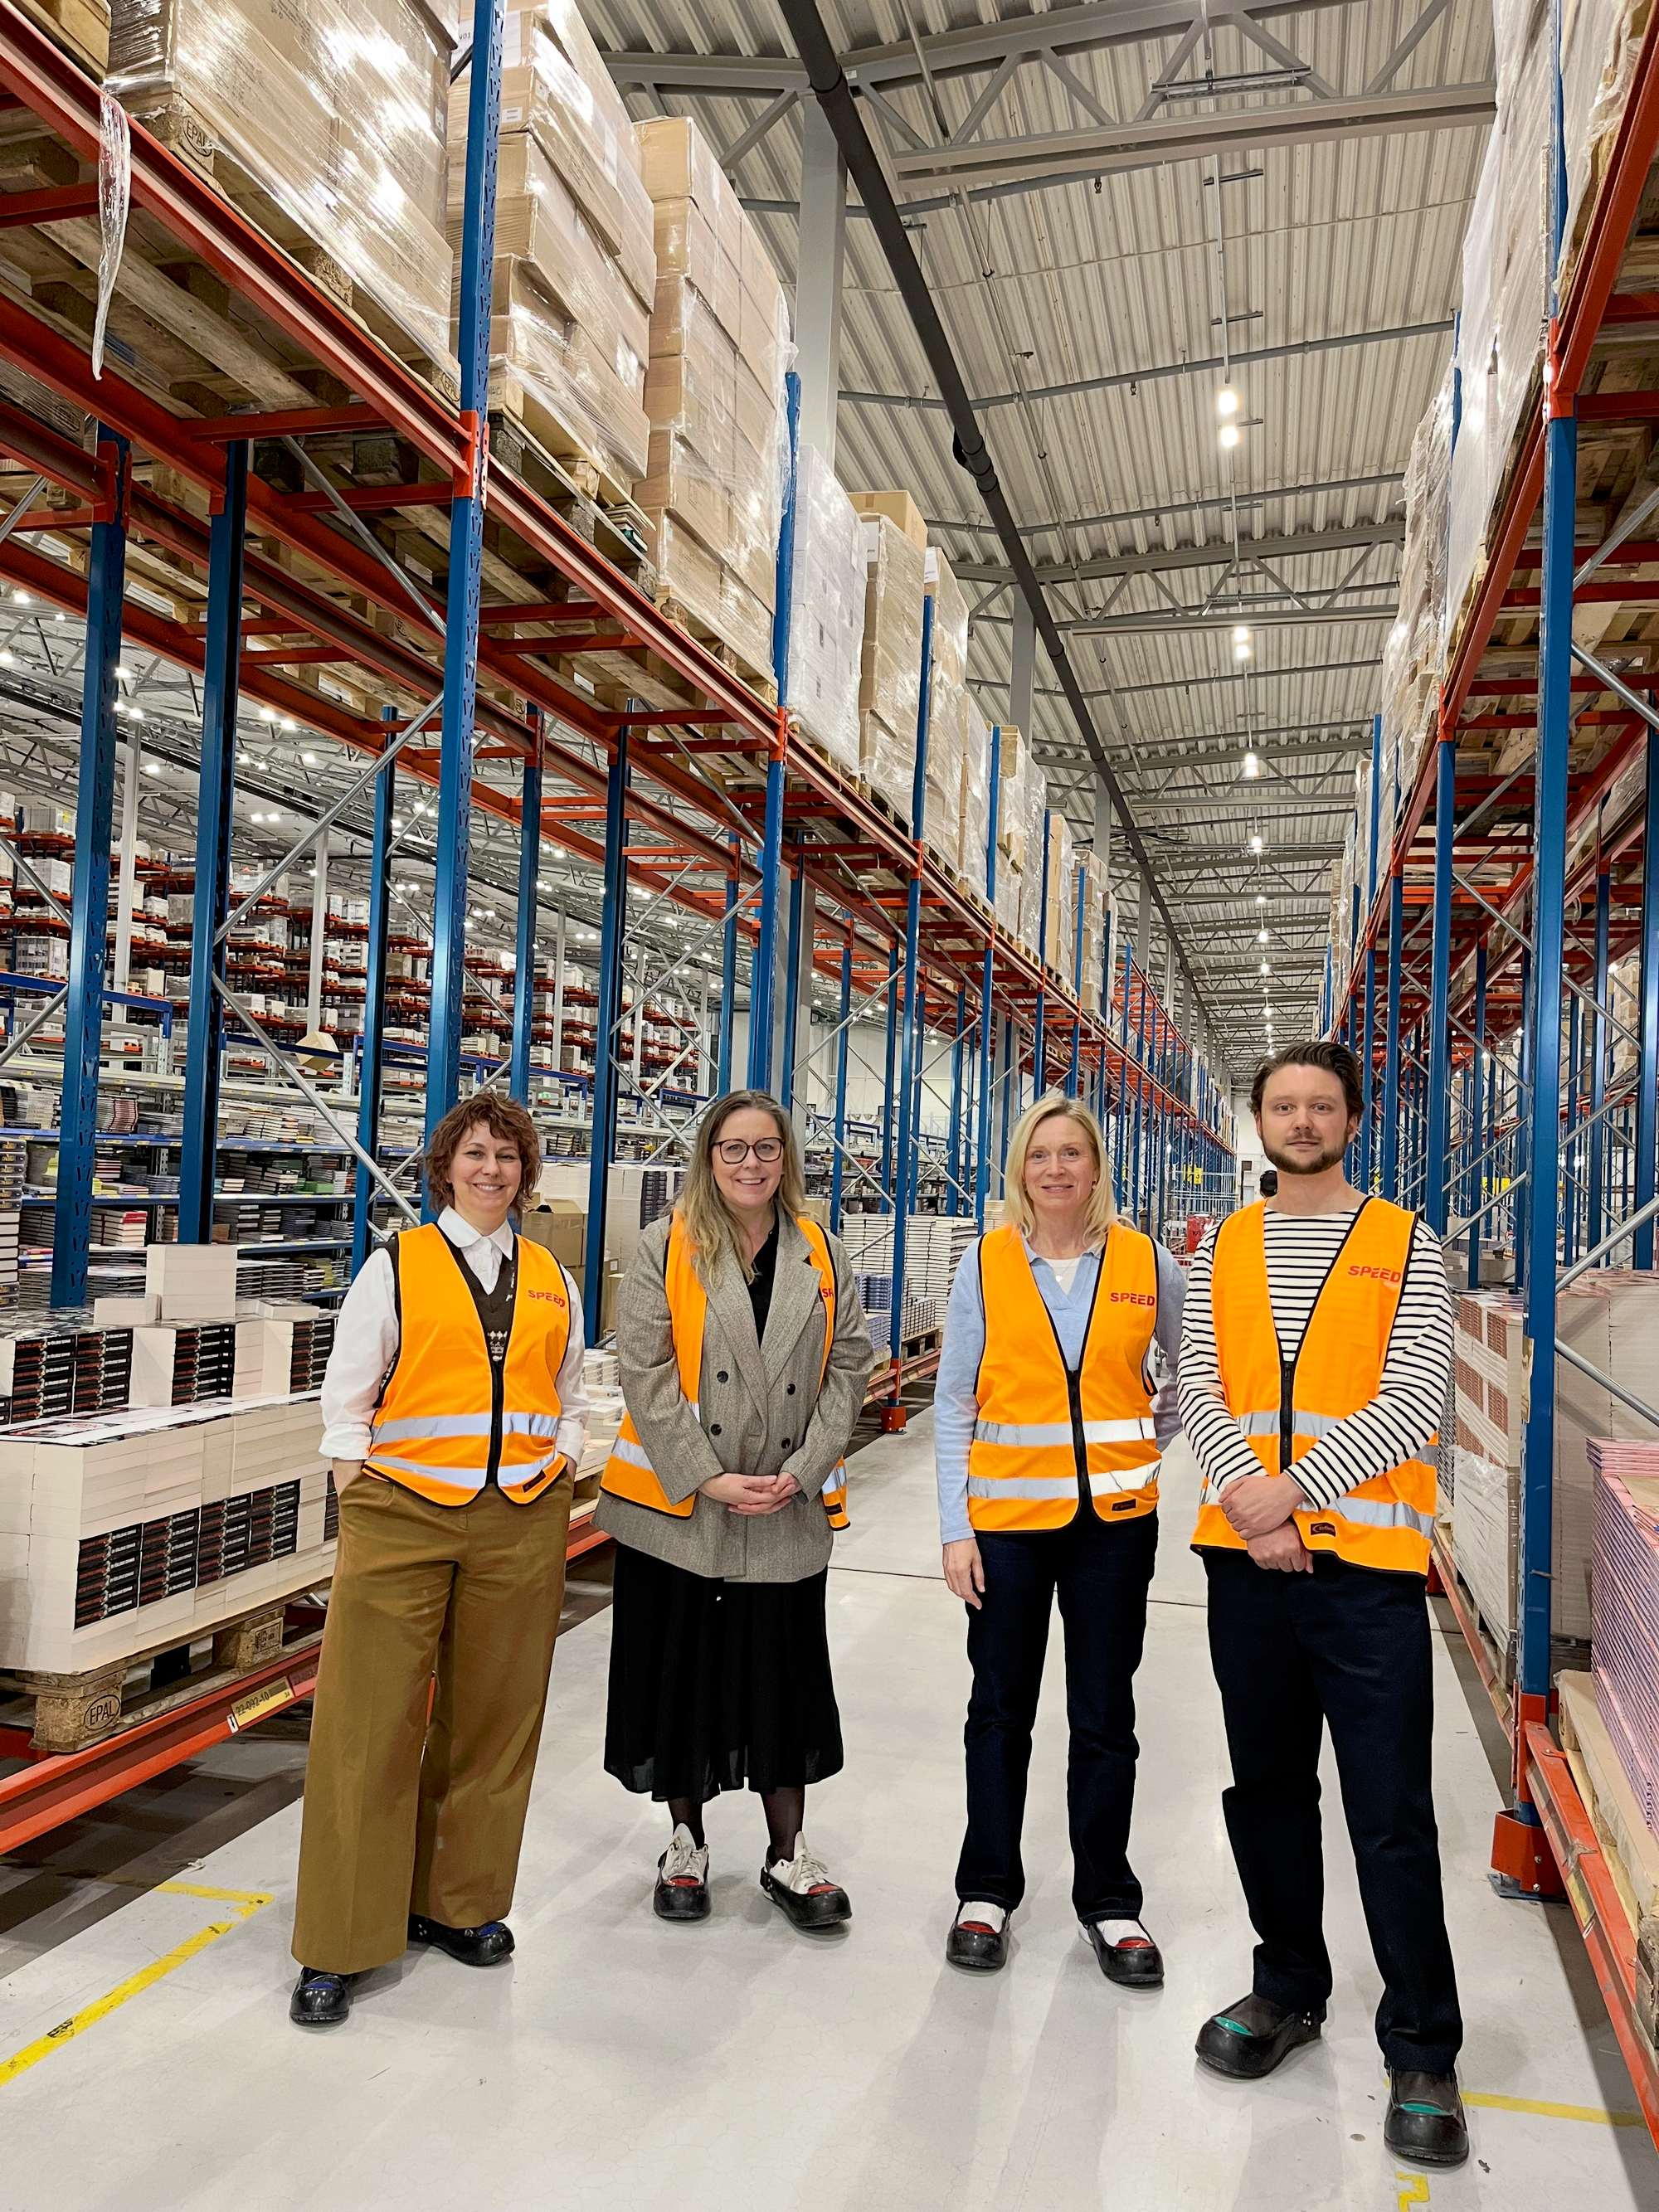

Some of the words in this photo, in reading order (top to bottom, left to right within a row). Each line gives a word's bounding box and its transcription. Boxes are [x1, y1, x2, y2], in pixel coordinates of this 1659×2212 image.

[1348, 1266, 1402, 1283] SPEED
[528, 1290, 566, 1308] SPEED
[1110, 1292, 1155, 1306] SPEED
[90, 1700, 114, 1725] EPAL
[236, 1691, 270, 1717] 22-092-10
